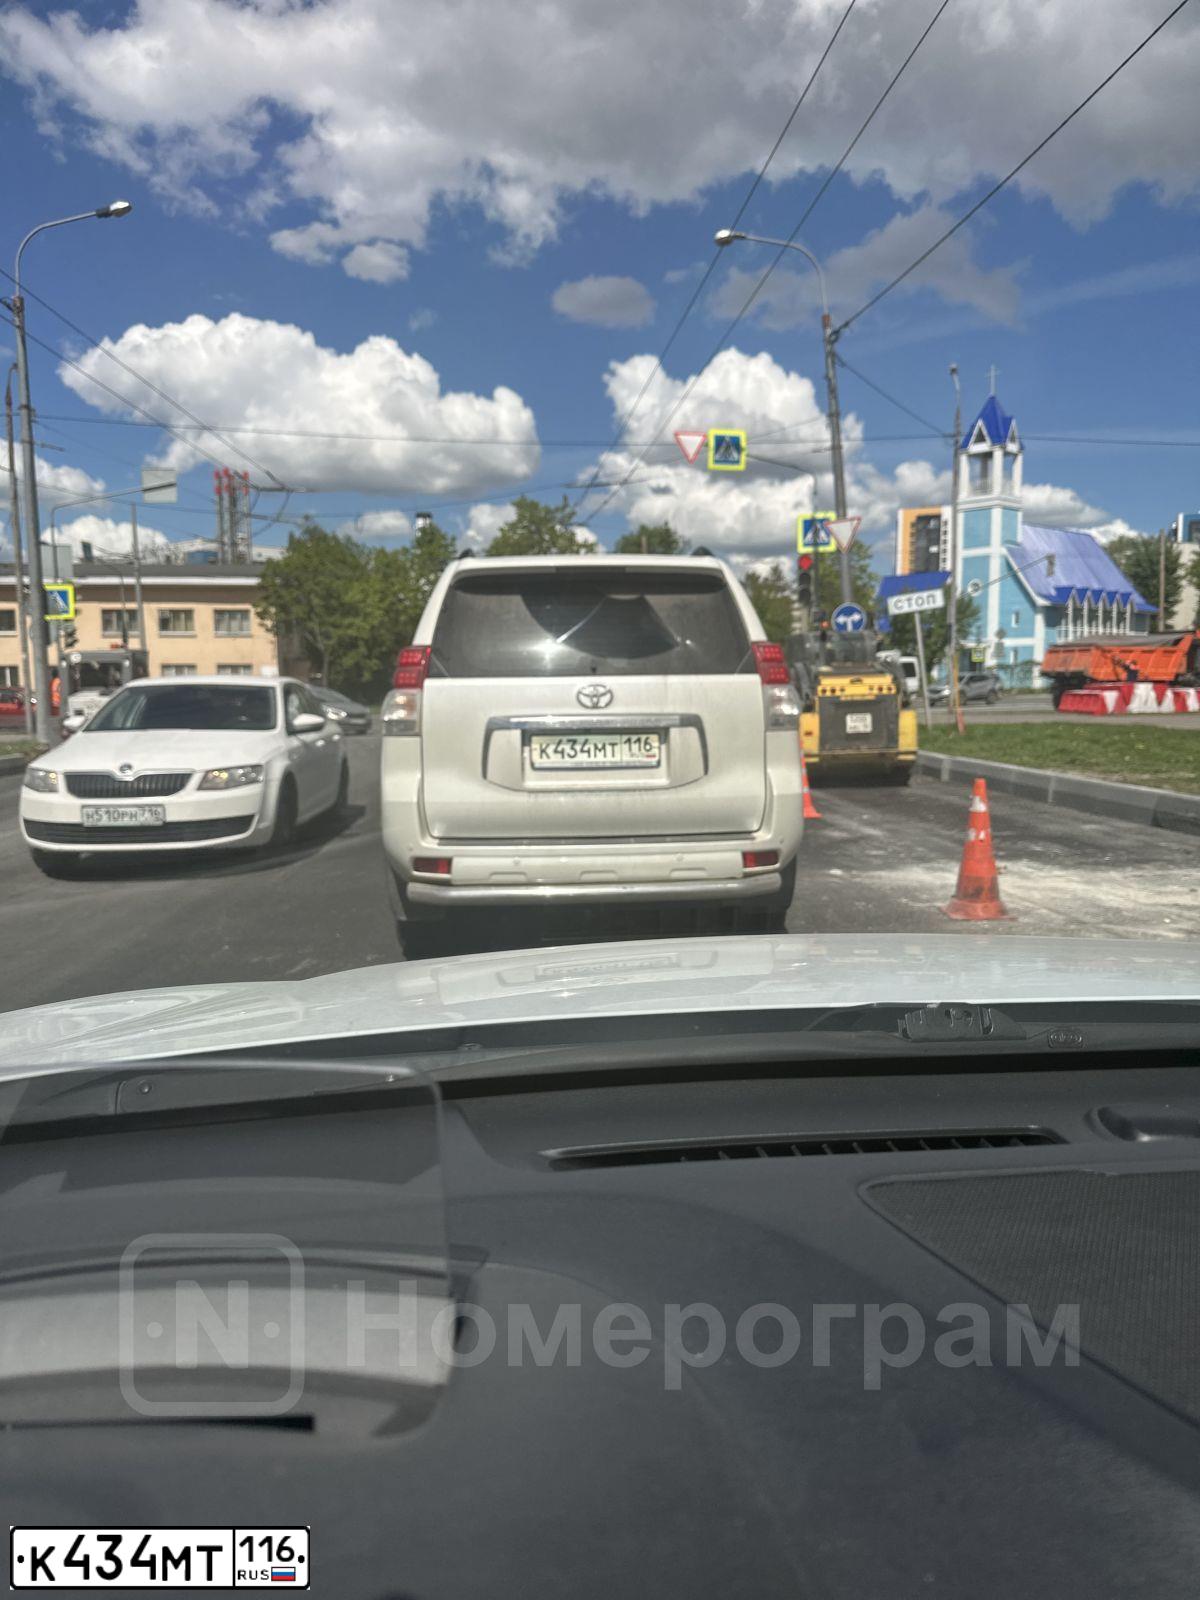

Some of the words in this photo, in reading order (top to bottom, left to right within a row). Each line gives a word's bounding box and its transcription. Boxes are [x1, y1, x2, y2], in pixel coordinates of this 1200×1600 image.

[893, 593, 936, 611] СТОП
[539, 738, 618, 759] К434МТ
[624, 737, 652, 752] 116
